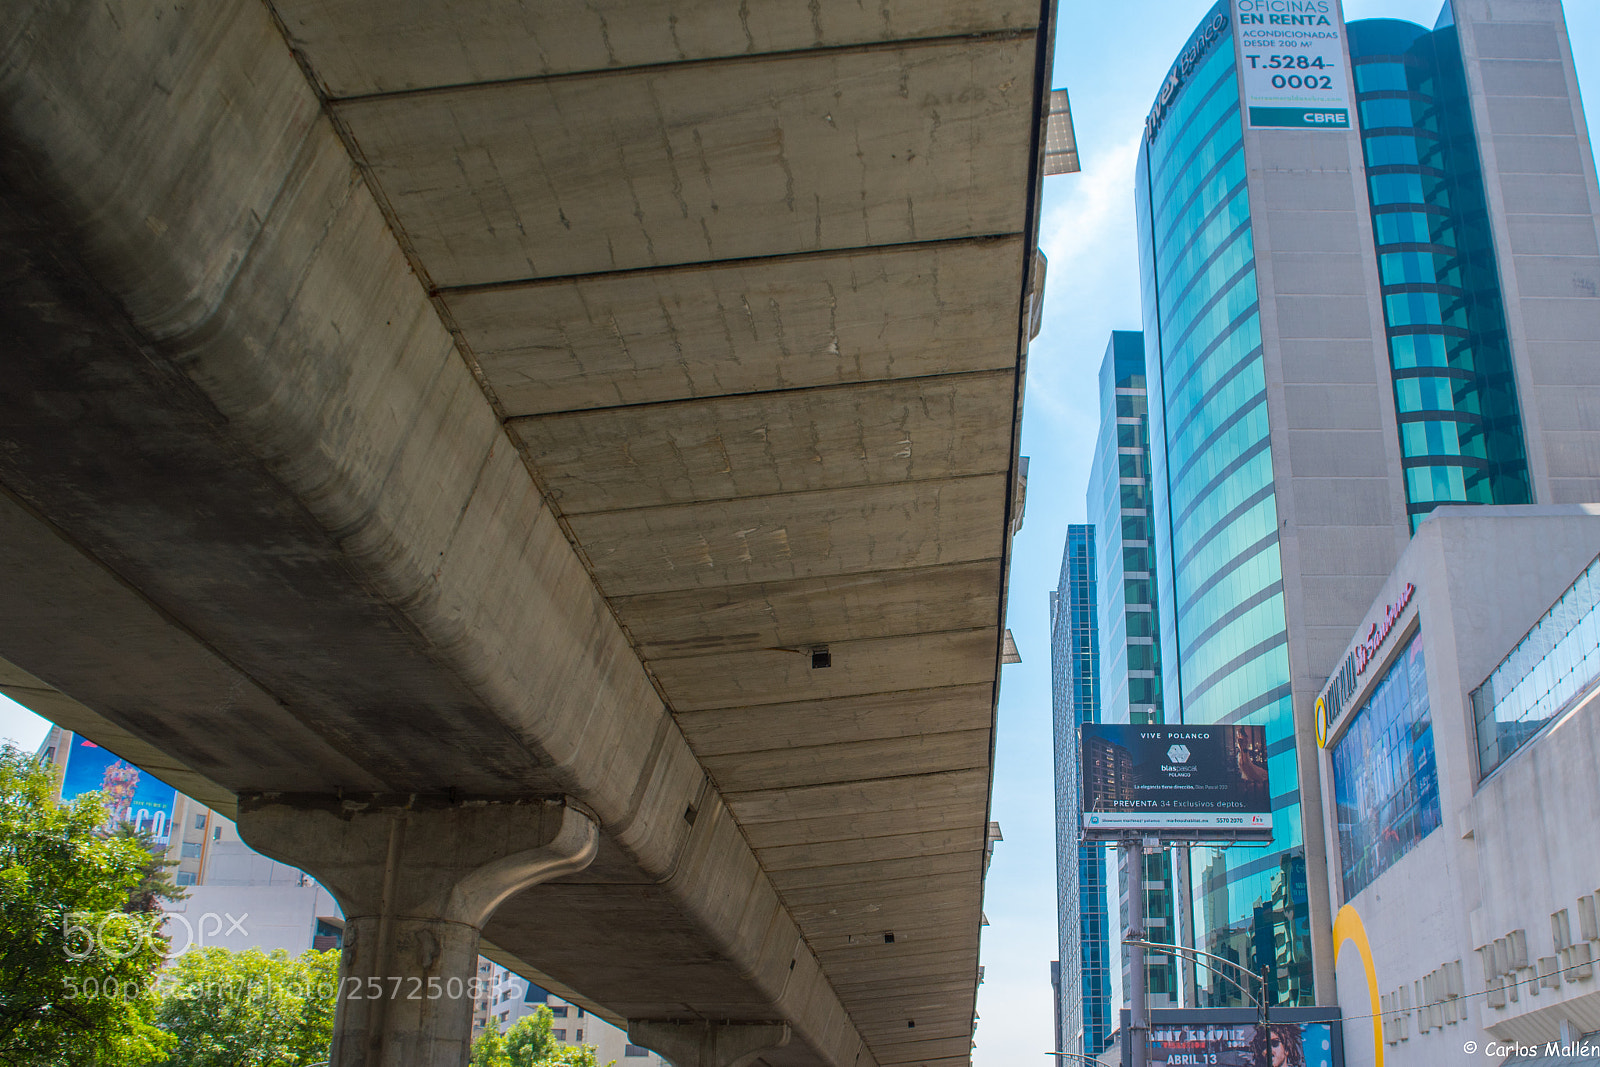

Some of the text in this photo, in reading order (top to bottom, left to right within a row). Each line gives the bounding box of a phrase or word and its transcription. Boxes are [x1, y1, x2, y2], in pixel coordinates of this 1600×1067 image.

[1238, 0, 1329, 13] OFICINAS
[1240, 13, 1331, 26] EN RENTA
[1243, 30, 1338, 39] ACONDICIONADAS
[1279, 40, 1298, 48] 200
[1271, 74, 1333, 90] 0002
[1303, 113, 1347, 123] CBRE
[1113, 800, 1247, 810] PREVENTA 34 Exclusivos deptos.
[1167, 1053, 1218, 1065] ABRIL 13
